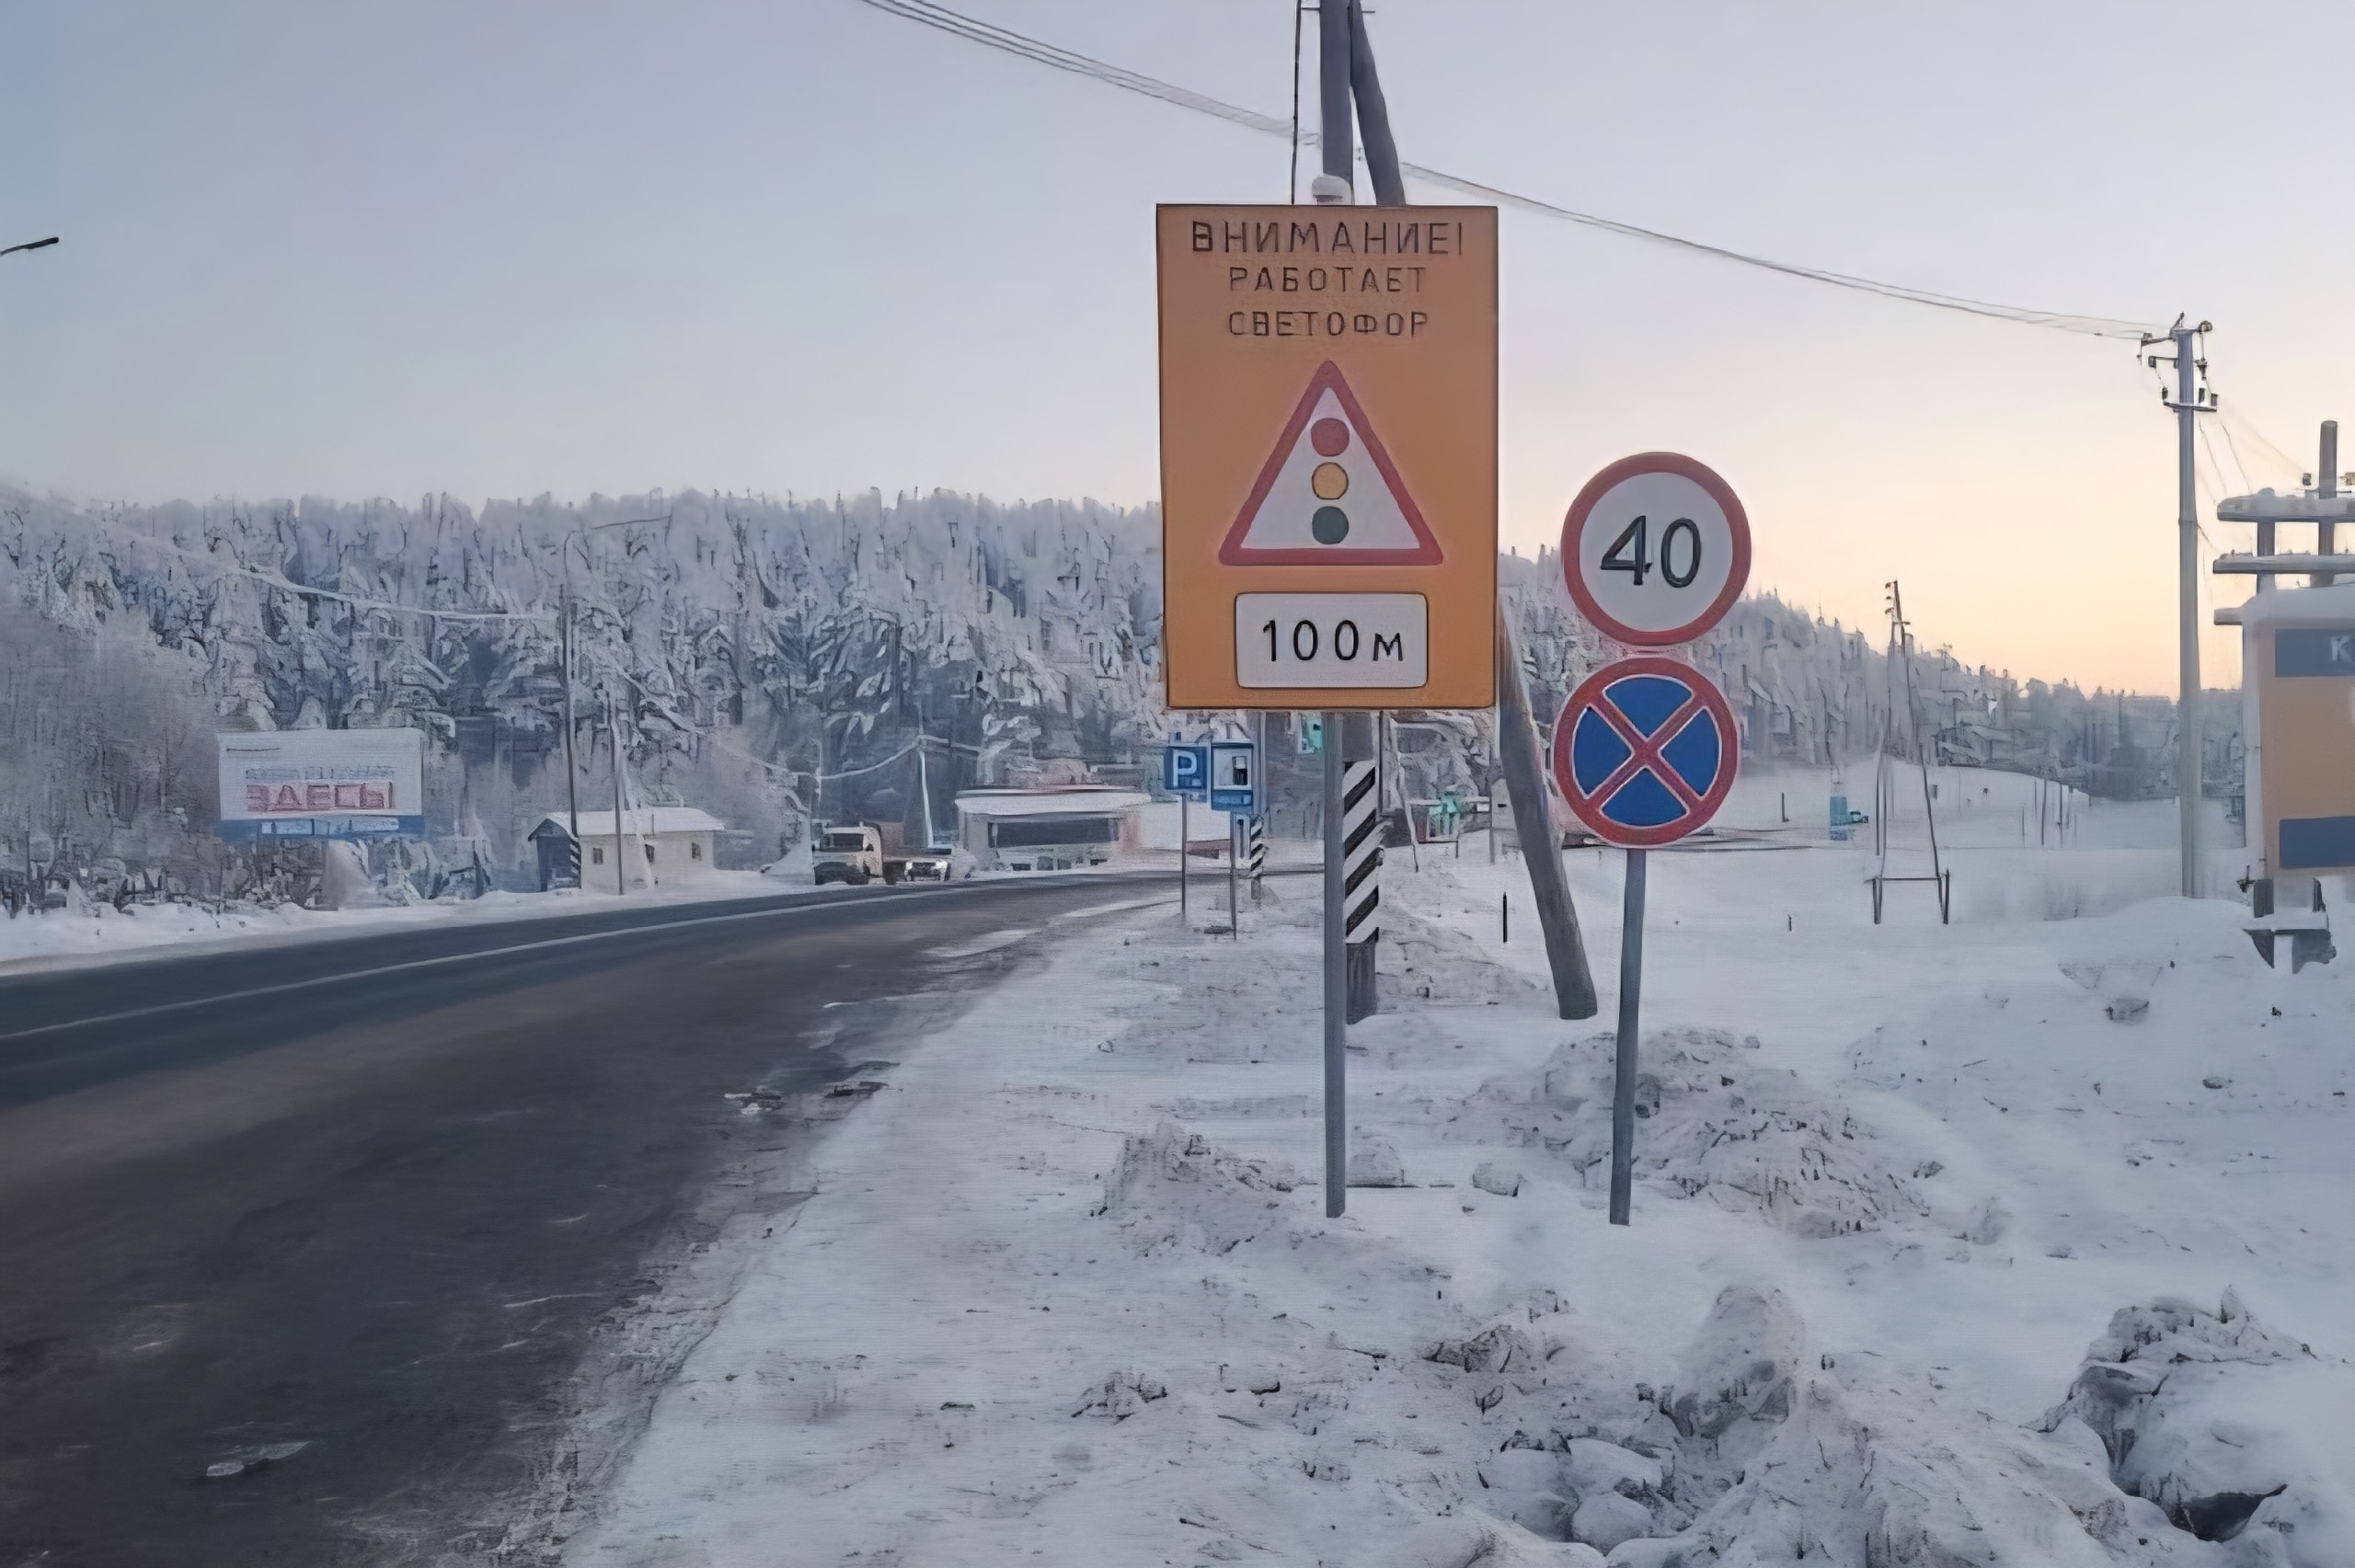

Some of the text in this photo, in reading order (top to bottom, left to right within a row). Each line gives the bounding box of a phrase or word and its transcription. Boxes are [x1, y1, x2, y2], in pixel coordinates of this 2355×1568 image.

[1192, 221, 1463, 256] ВНИМАНИЕ!
[1229, 267, 1427, 292] РАБОТАЕТ
[1228, 311, 1428, 337] СВЕТОФОР
[1600, 515, 1702, 588] 40
[1173, 750, 1197, 787] P
